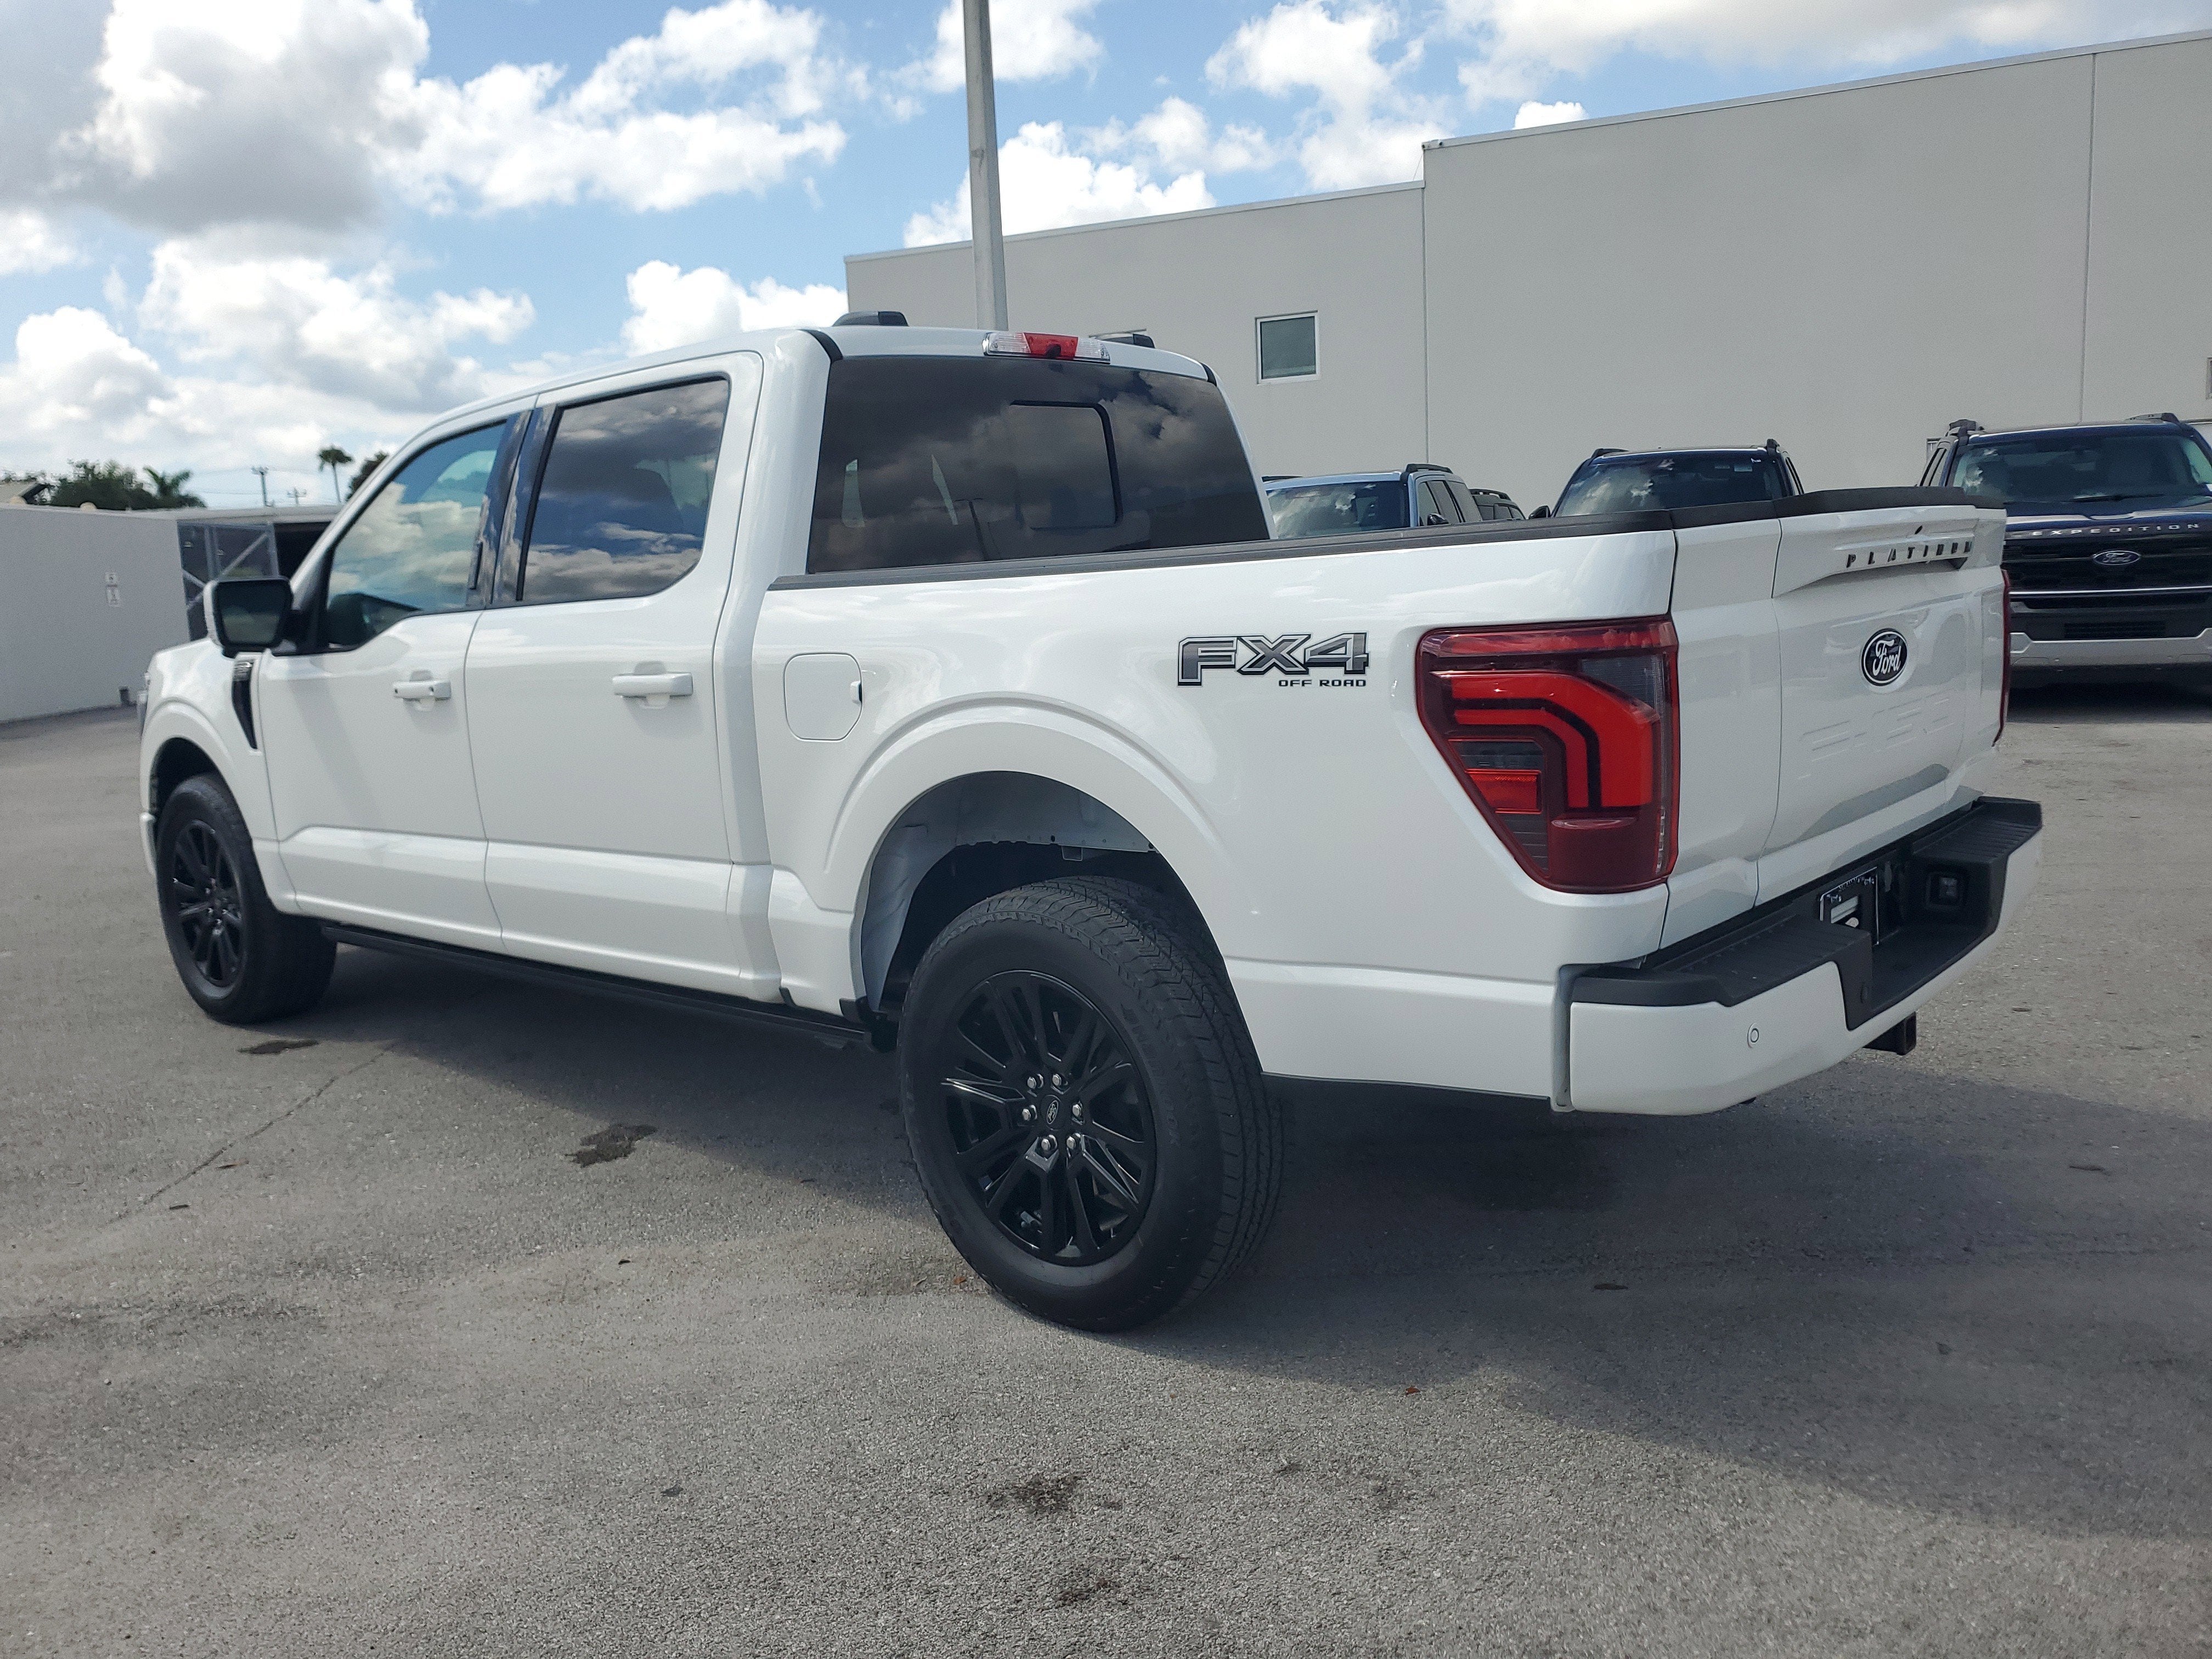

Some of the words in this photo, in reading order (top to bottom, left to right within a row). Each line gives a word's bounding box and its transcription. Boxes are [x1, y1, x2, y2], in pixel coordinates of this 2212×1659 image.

[2032, 523, 2200, 536] EXPEDITION
[1178, 633, 1369, 686] FX4
[1872, 639, 1902, 677] Ford
[1278, 679, 1312, 687] OFF
[1319, 679, 1367, 687] ROAD
